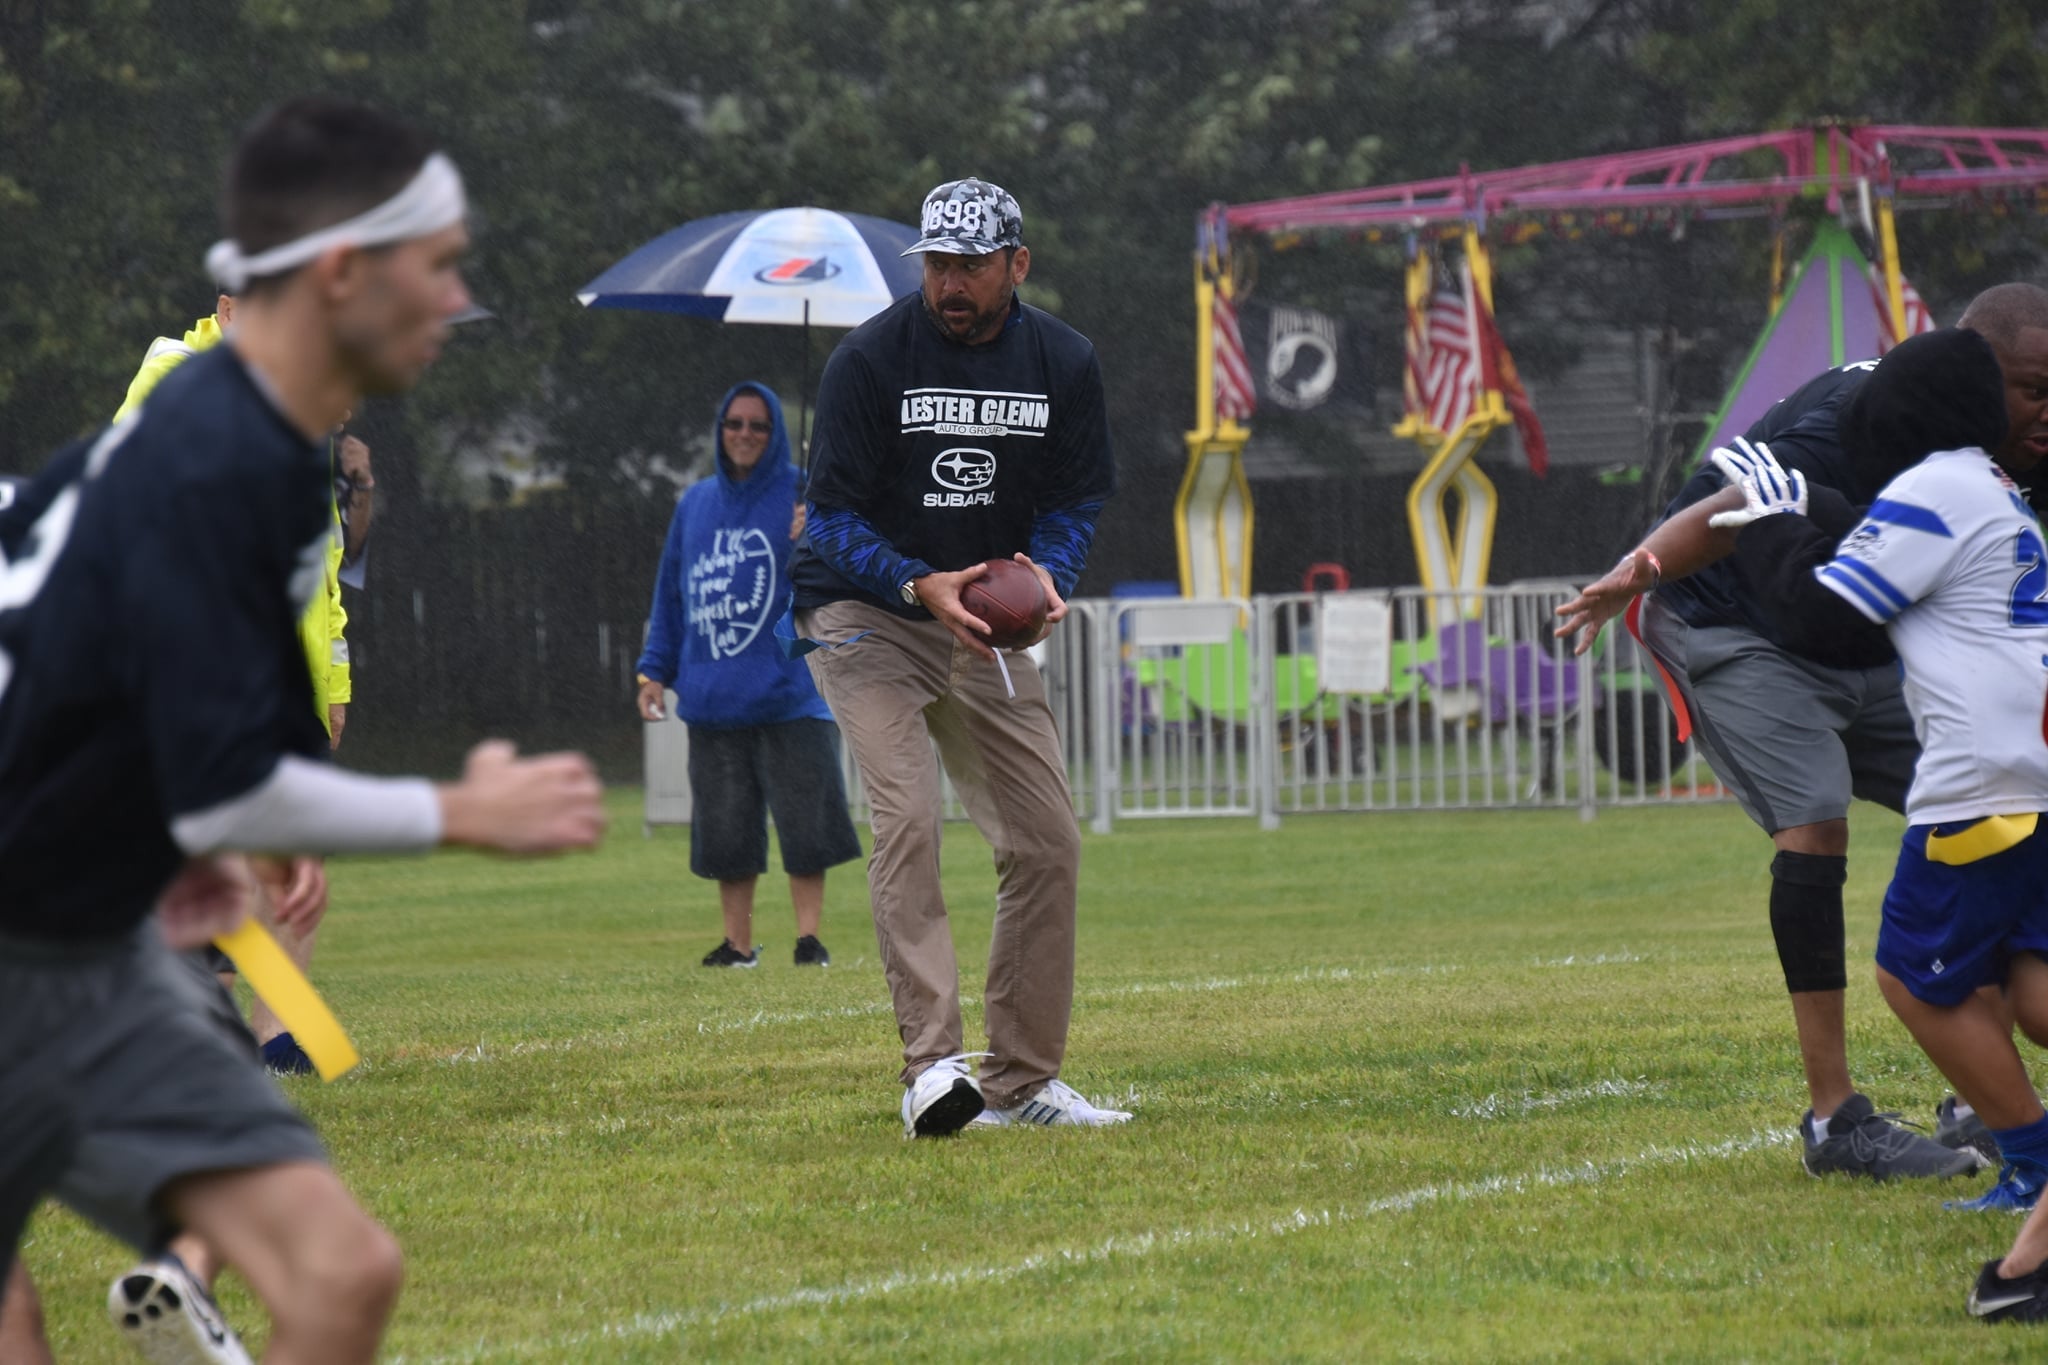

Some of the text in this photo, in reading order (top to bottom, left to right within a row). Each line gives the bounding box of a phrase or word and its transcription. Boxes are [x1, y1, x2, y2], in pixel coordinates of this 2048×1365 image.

[923, 199, 982, 232] 1898
[901, 395, 1050, 429] LESTER GLENN
[938, 423, 1003, 436] AUTO GROUP
